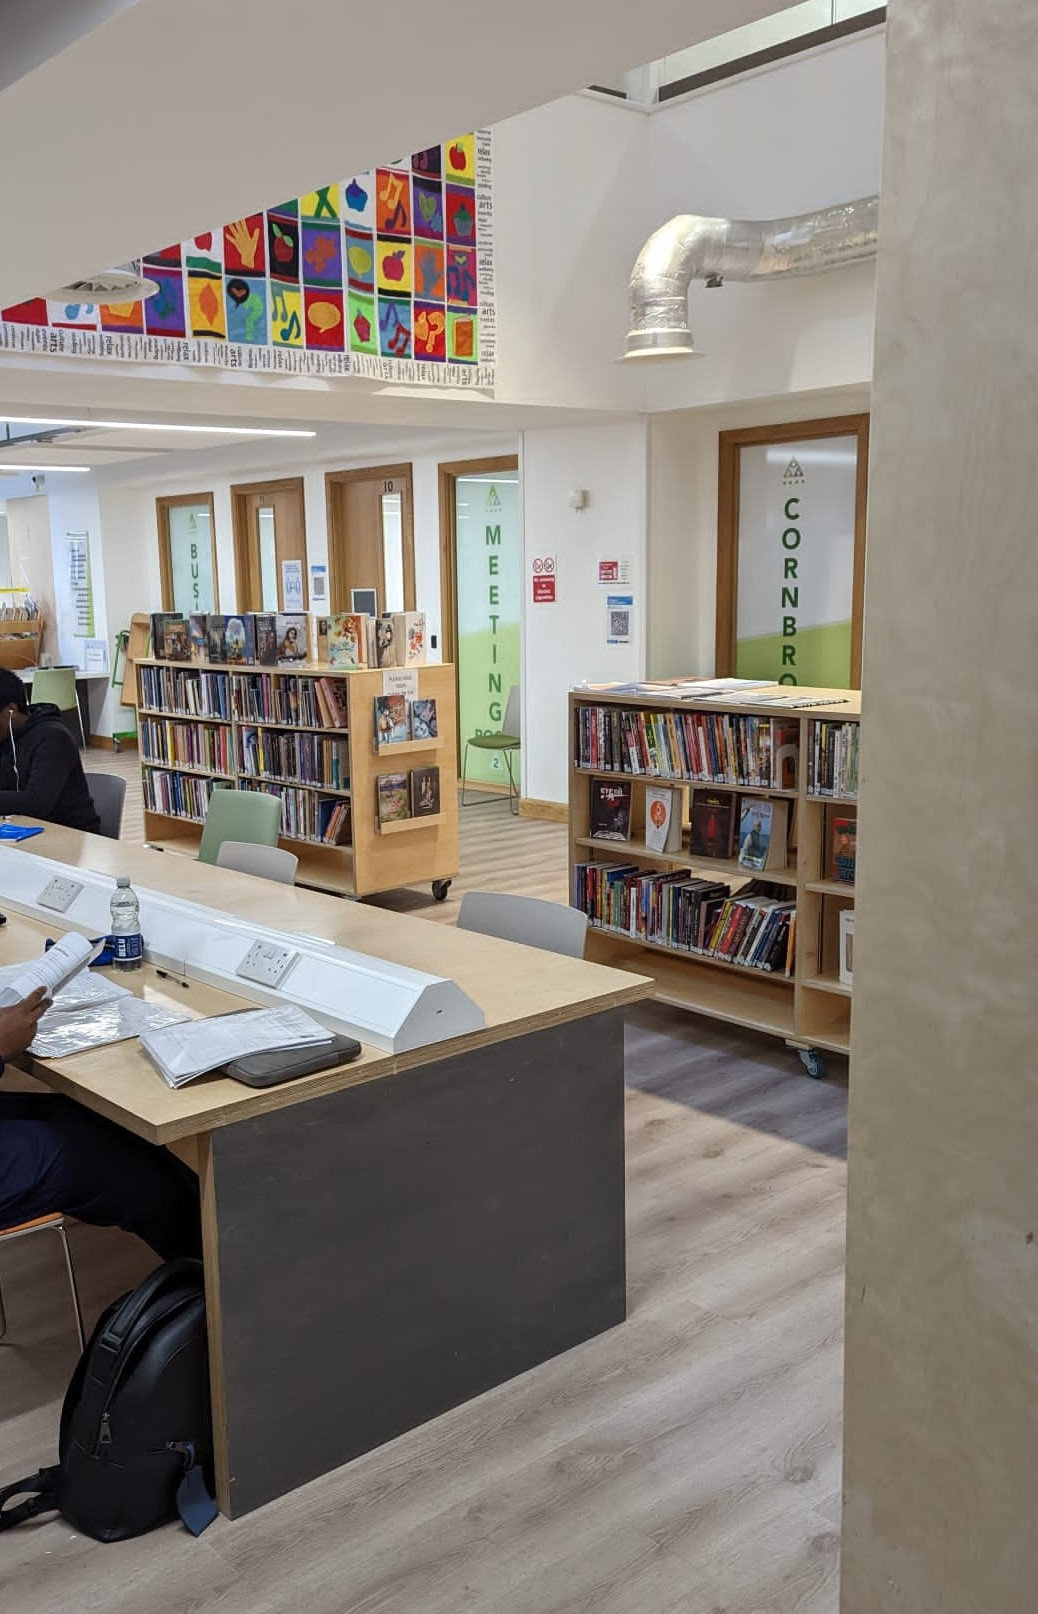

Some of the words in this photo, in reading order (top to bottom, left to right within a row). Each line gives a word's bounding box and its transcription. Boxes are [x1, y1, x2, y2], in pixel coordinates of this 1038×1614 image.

[478, 201, 492, 209] arts
[482, 308, 496, 316] arts
[50, 332, 58, 353] arts
[106, 335, 114, 356] relax
[182, 342, 191, 360] relax
[230, 348, 238, 368] arts
[384, 480, 393, 492] 10
[485, 525, 502, 722] MEETING
[494, 758, 498, 768] 2
